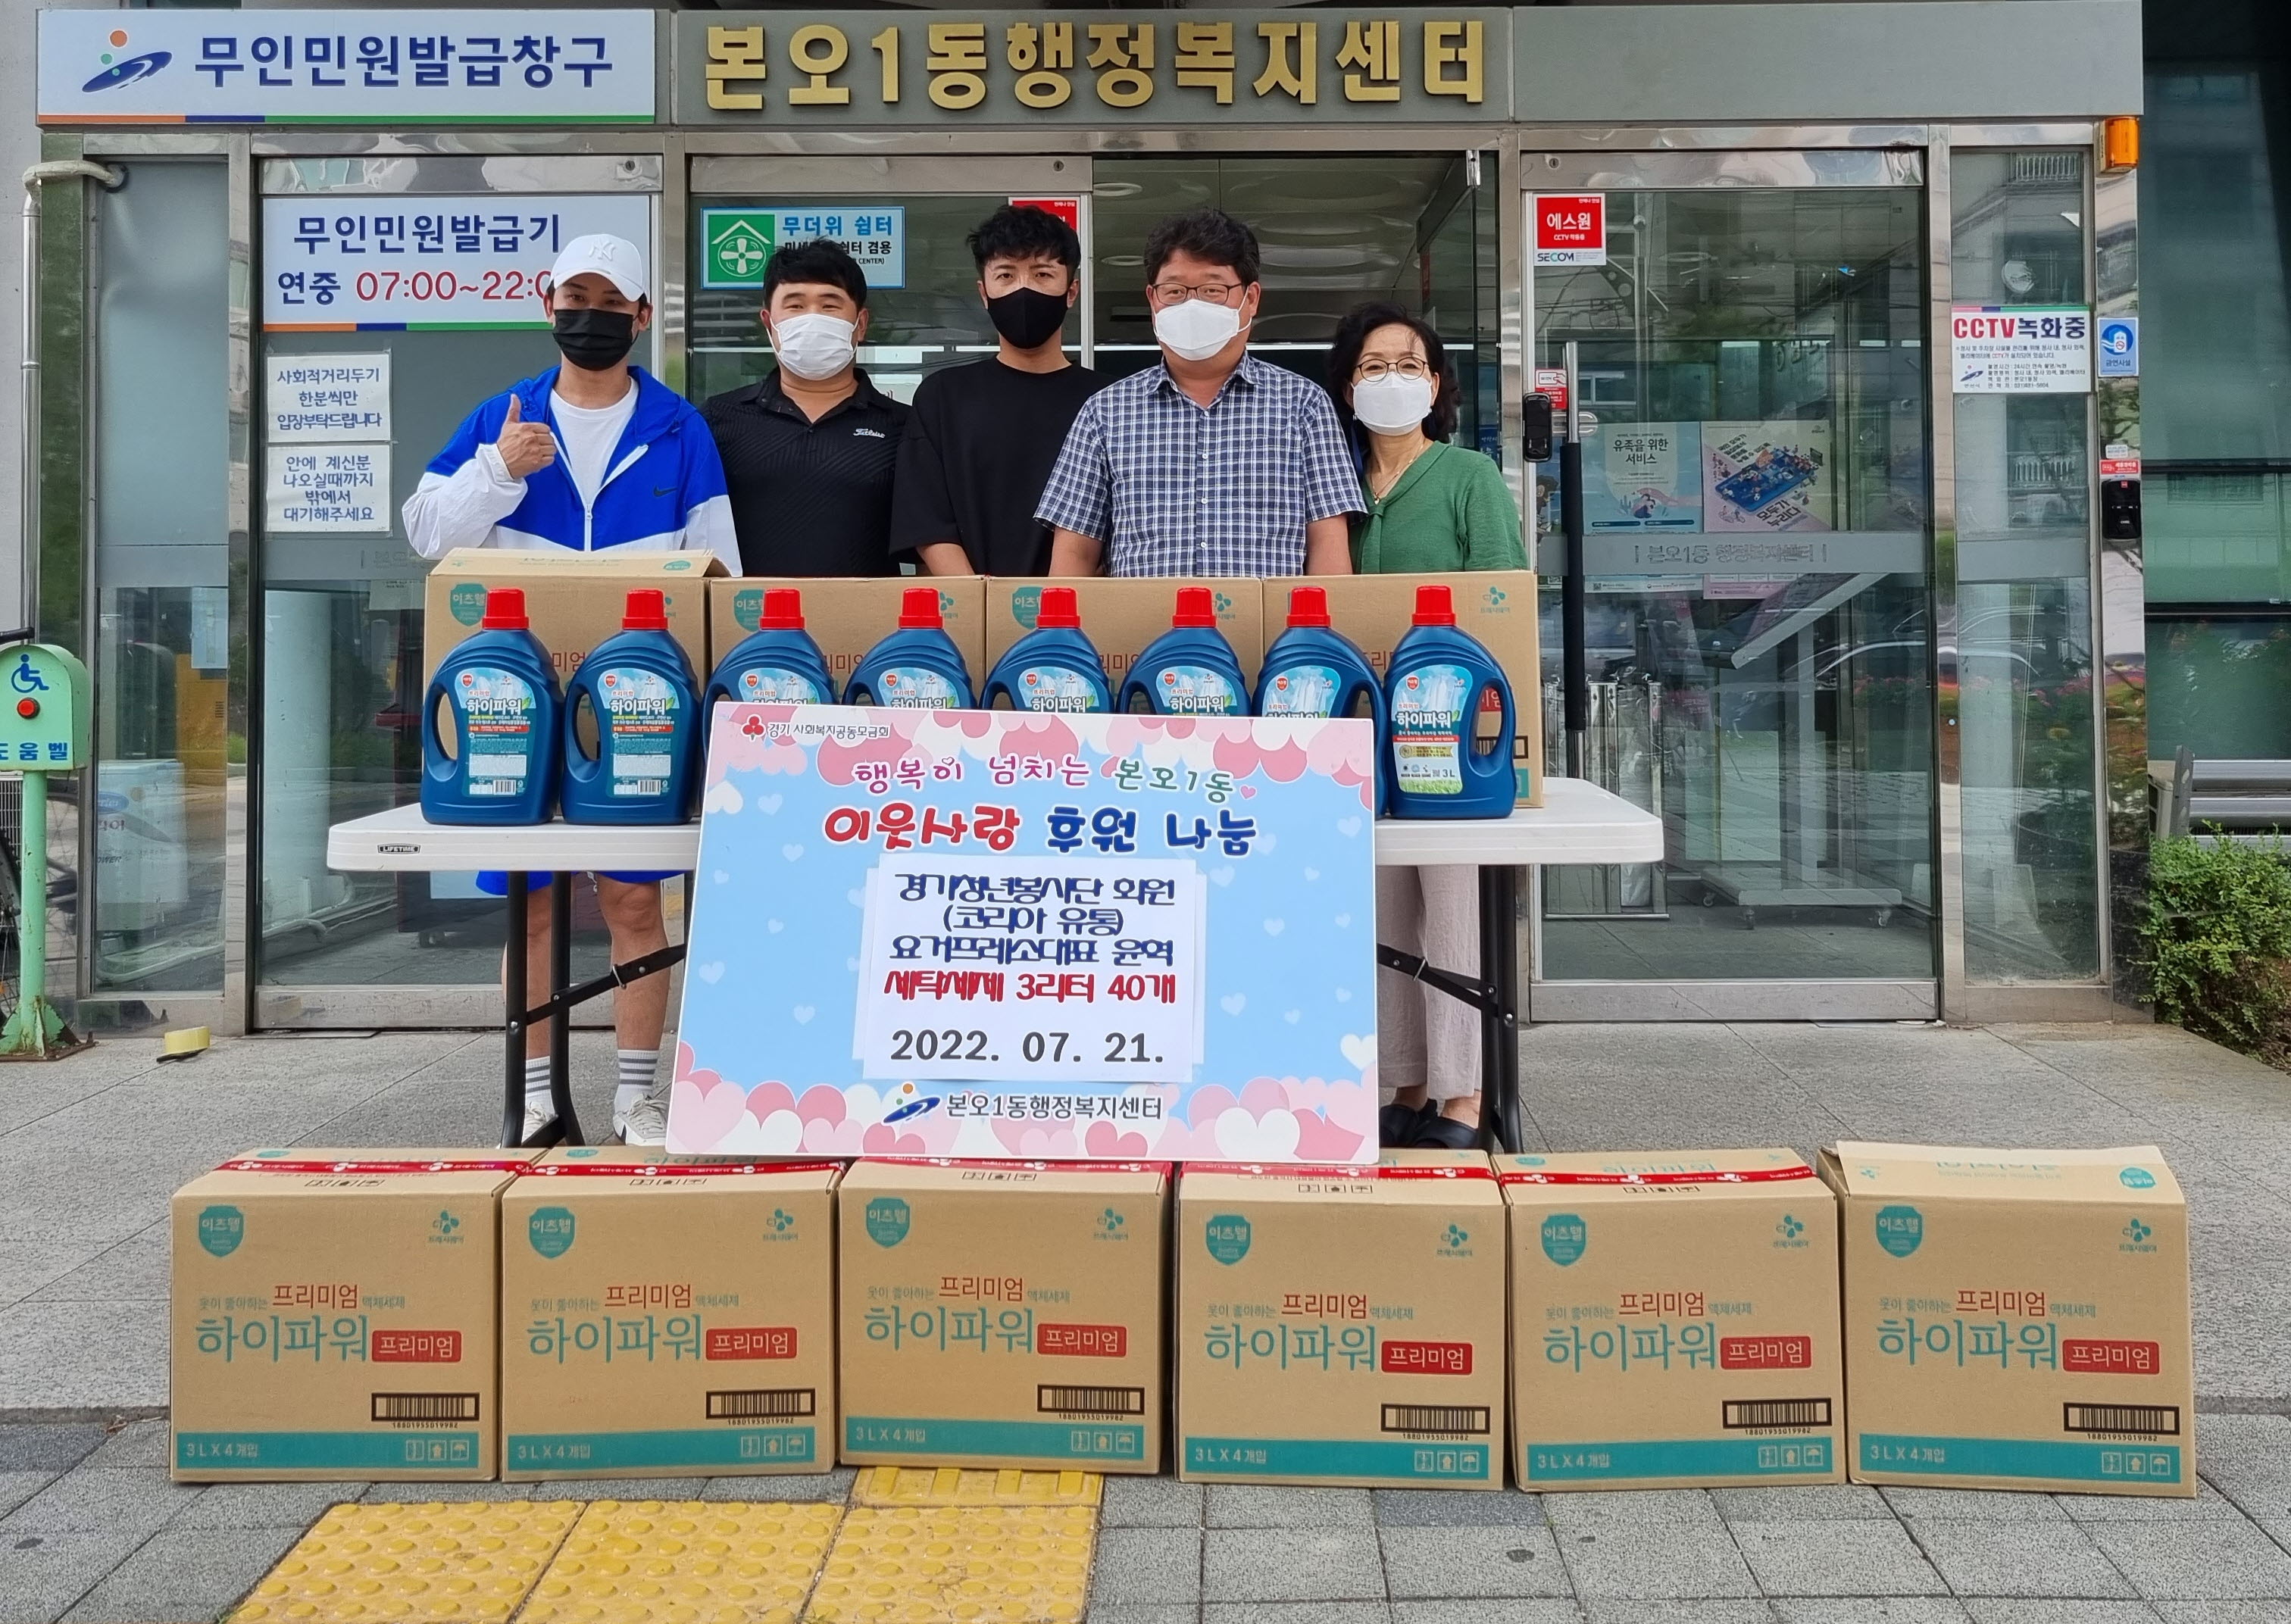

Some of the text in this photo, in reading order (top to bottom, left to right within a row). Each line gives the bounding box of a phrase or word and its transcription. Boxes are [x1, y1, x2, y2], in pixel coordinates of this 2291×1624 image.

[195, 34, 614, 89] 무인민원발급창구
[705, 20, 1485, 110] 본오1동행정복지센터
[783, 216, 892, 236] 무더위 쉼터
[1547, 212, 1591, 230] 에스원
[294, 214, 561, 254] 무인민원발급기
[867, 242, 892, 255] 겸용
[1537, 252, 1574, 261] SECOM
[278, 270, 551, 305] 연중 07:00~22:0
[1954, 317, 2085, 339] CCTV녹화중
[277, 368, 380, 384] 사회적거리두기
[298, 391, 358, 408] 한분씩만
[277, 413, 382, 430] 입장부탁드립니다
[853, 429, 885, 439] Titleist
[1614, 439, 1668, 451] 유족을 위한
[286, 455, 370, 472] 안에 계신분
[1626, 454, 1657, 464] 서비스
[283, 473, 373, 488] 나오실때까지
[305, 490, 351, 505] 밖에서
[284, 507, 374, 522] 대기해주세요
[1757, 500, 1790, 520] 모두가
[1767, 507, 1801, 526] 누리다
[1648, 545, 1709, 564] 본오1동
[467, 699, 521, 715] 하이파워
[611, 699, 664, 715] 하이파워
[1031, 697, 1086, 713] 하이파워
[1170, 696, 1224, 713] 하이파워
[1397, 711, 1451, 729] 하이파워
[768, 723, 889, 739] 경기 사회복지공동모금회
[852, 755, 1235, 805] 행복이 넘치는 본오1동
[824, 804, 1256, 857] 이웃사랑 후원 나눔
[895, 873, 1175, 906] 경기청년봉사단 회원
[943, 904, 1124, 936] (코리아 유통)
[889, 935, 1099, 966] 요거프레소대표
[884, 970, 1175, 1004] 세탁세제 3리터 40개
[890, 1029, 1163, 1063] 2022. 07. 21.
[946, 1094, 1162, 1120] 본오1동행정복지센터
[202, 1216, 240, 1232] 이츠웰
[869, 1207, 905, 1223] 이츠웰
[532, 1218, 570, 1234] 이츠웰
[1209, 1224, 1247, 1241] 이츠웰
[1545, 1226, 1582, 1241] 이츠웰
[1879, 1217, 1919, 1233] 이츠웰
[272, 1284, 358, 1310] 프리미엄
[605, 1283, 691, 1310] 프리미엄
[939, 1276, 1024, 1302] 프리미엄
[1281, 1293, 1367, 1320] 프리미엄
[1618, 1291, 1705, 1317] 프리미엄
[1955, 1289, 2046, 1317] 프리미엄
[195, 1314, 453, 1363] 하이파워 프리미엄
[527, 1313, 789, 1364] 하이파워 프리미엄
[864, 1304, 1118, 1354] 하이파워 프리미엄
[1204, 1323, 1464, 1372] 하이파워 프리미엄
[1542, 1321, 1803, 1373] 하이파워 프리미엄
[1877, 1317, 2150, 1370] 하이파워 프리미엄
